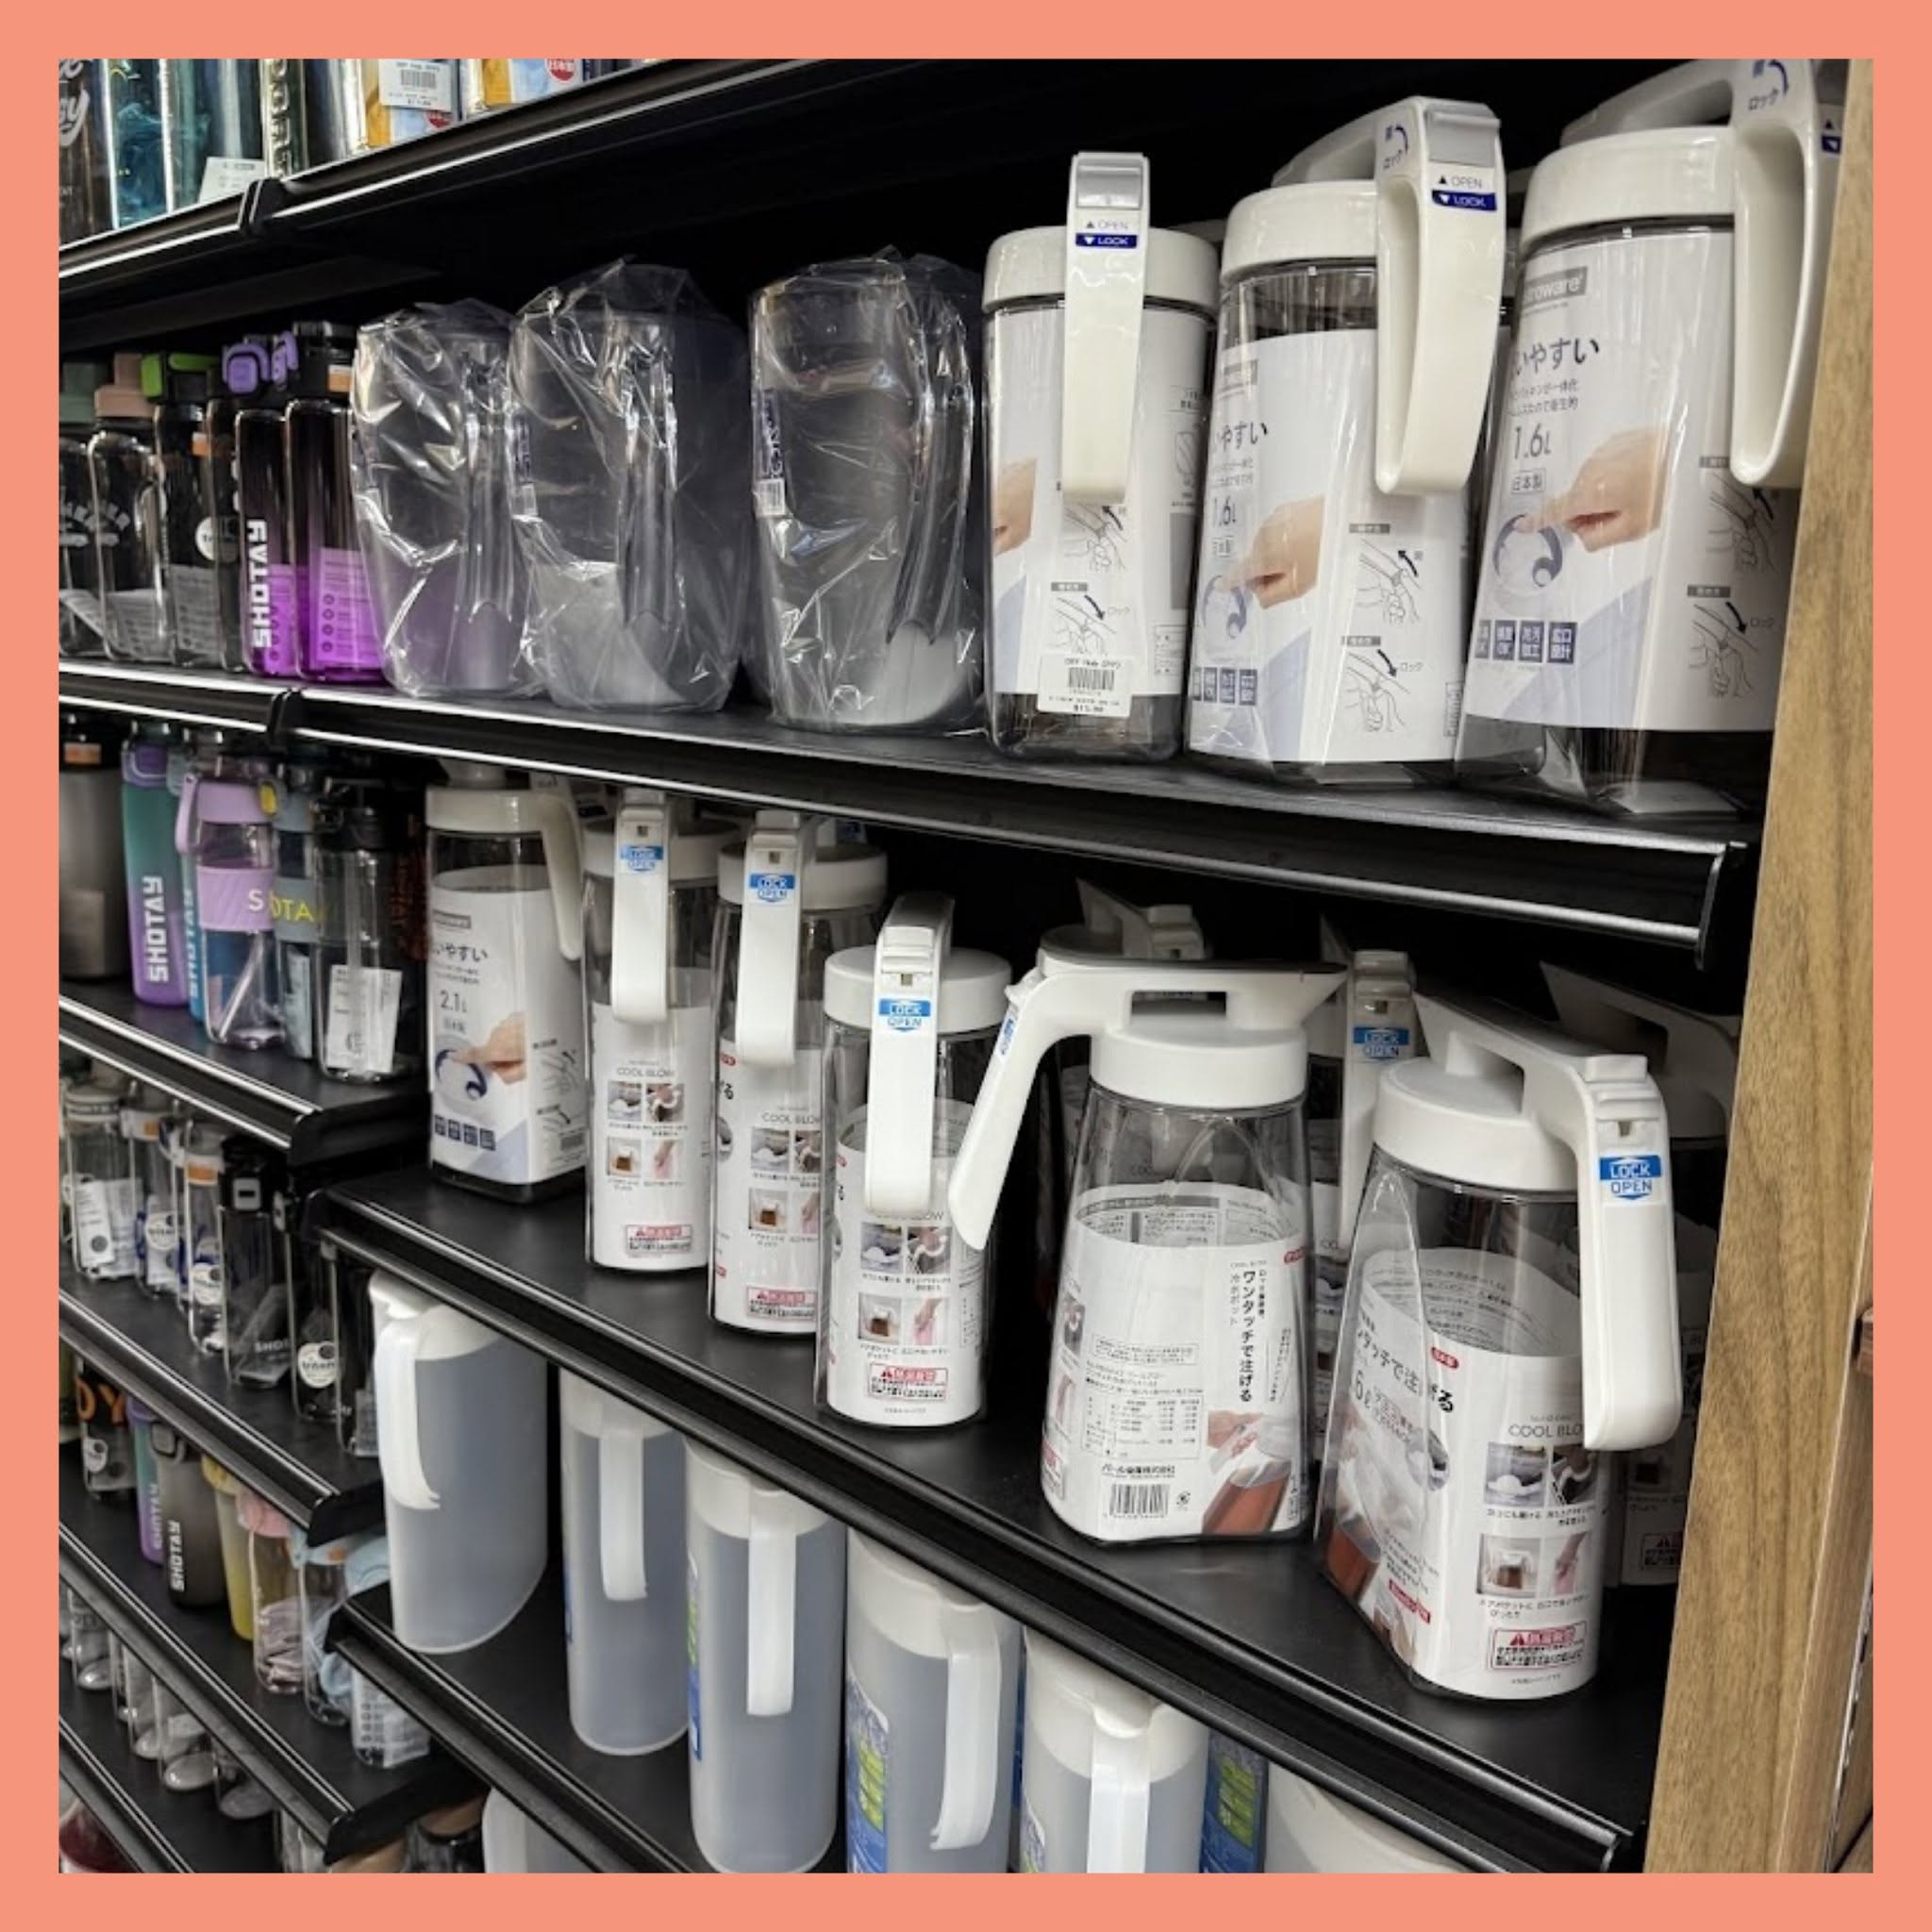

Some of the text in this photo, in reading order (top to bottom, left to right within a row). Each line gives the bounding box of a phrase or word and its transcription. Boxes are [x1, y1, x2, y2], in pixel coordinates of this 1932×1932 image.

[1451, 175, 1482, 189] OPEN
[1454, 194, 1487, 207] LOCK
[1097, 219, 1128, 229] OPEN
[1097, 236, 1128, 245] LOCK
[247, 520, 272, 648] SHOTAY
[758, 877, 789, 890] LOCK
[758, 889, 788, 899] OPEN
[142, 875, 169, 982] SHOTAY
[887, 1017, 922, 1027] OPEN
[1363, 1045, 1400, 1057] OPEN
[761, 1111, 791, 1124] COOL
[1610, 1161, 1651, 1177] LOCK
[1610, 1180, 1653, 1194] OPEN
[1239, 1271, 1257, 1403] ワンタッチで注げる
[1508, 1424, 1554, 1438] COOL
[169, 1520, 185, 1592] SHOTAY
